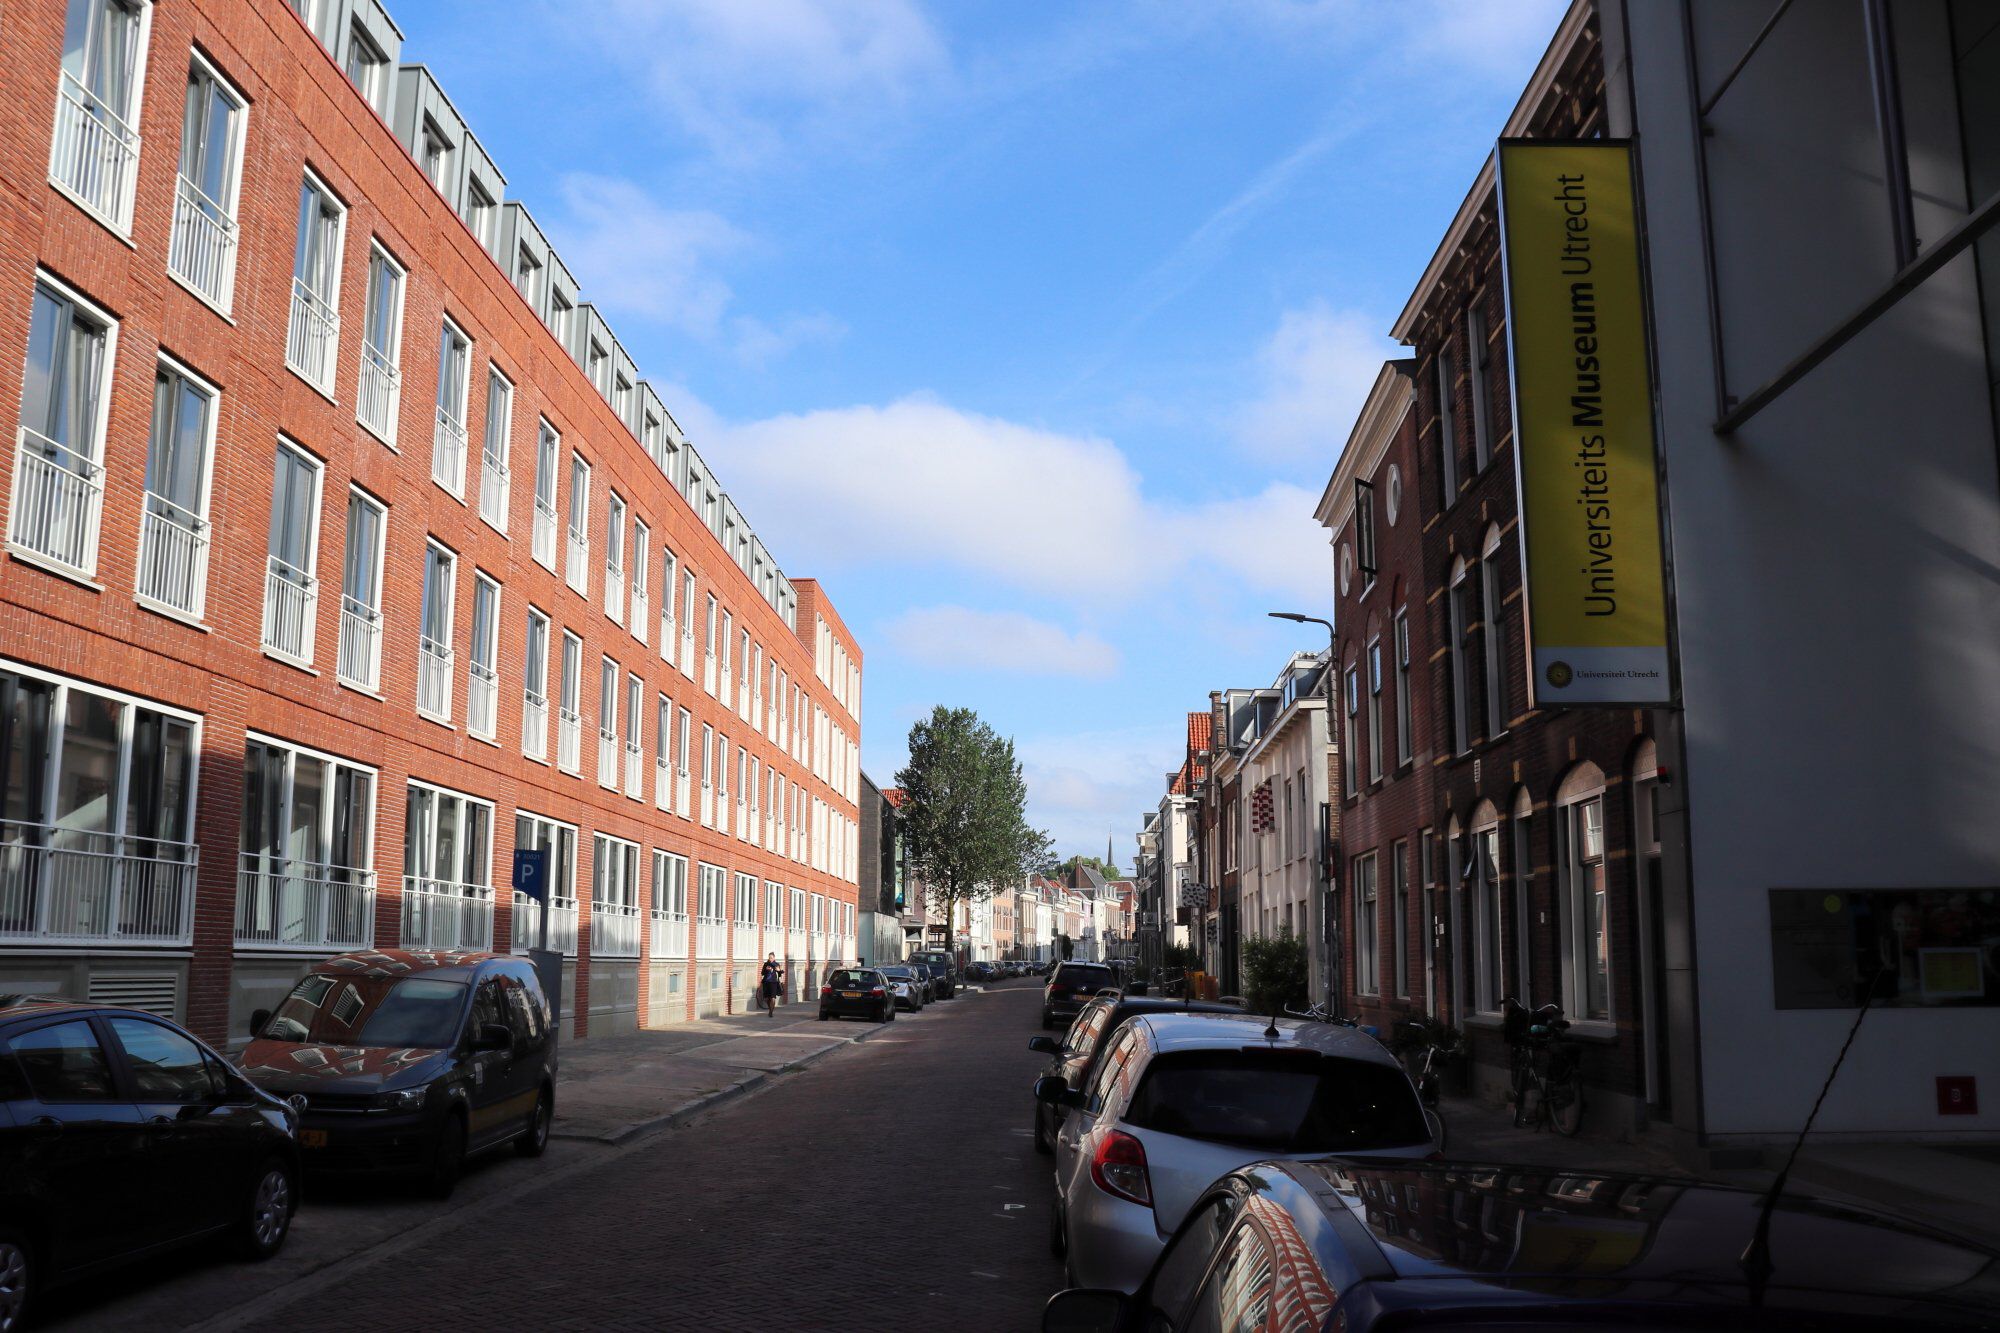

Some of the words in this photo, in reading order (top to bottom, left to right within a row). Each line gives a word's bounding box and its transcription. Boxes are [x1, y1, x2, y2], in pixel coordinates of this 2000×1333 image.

[1553, 173, 1592, 275] Utrecht
[1570, 282, 1604, 427] Museum
[1574, 434, 1616, 617] Universiteits
[1576, 669, 1625, 679] Universiteit
[1627, 669, 1659, 679] Utrecht
[521, 863, 534, 884] P
